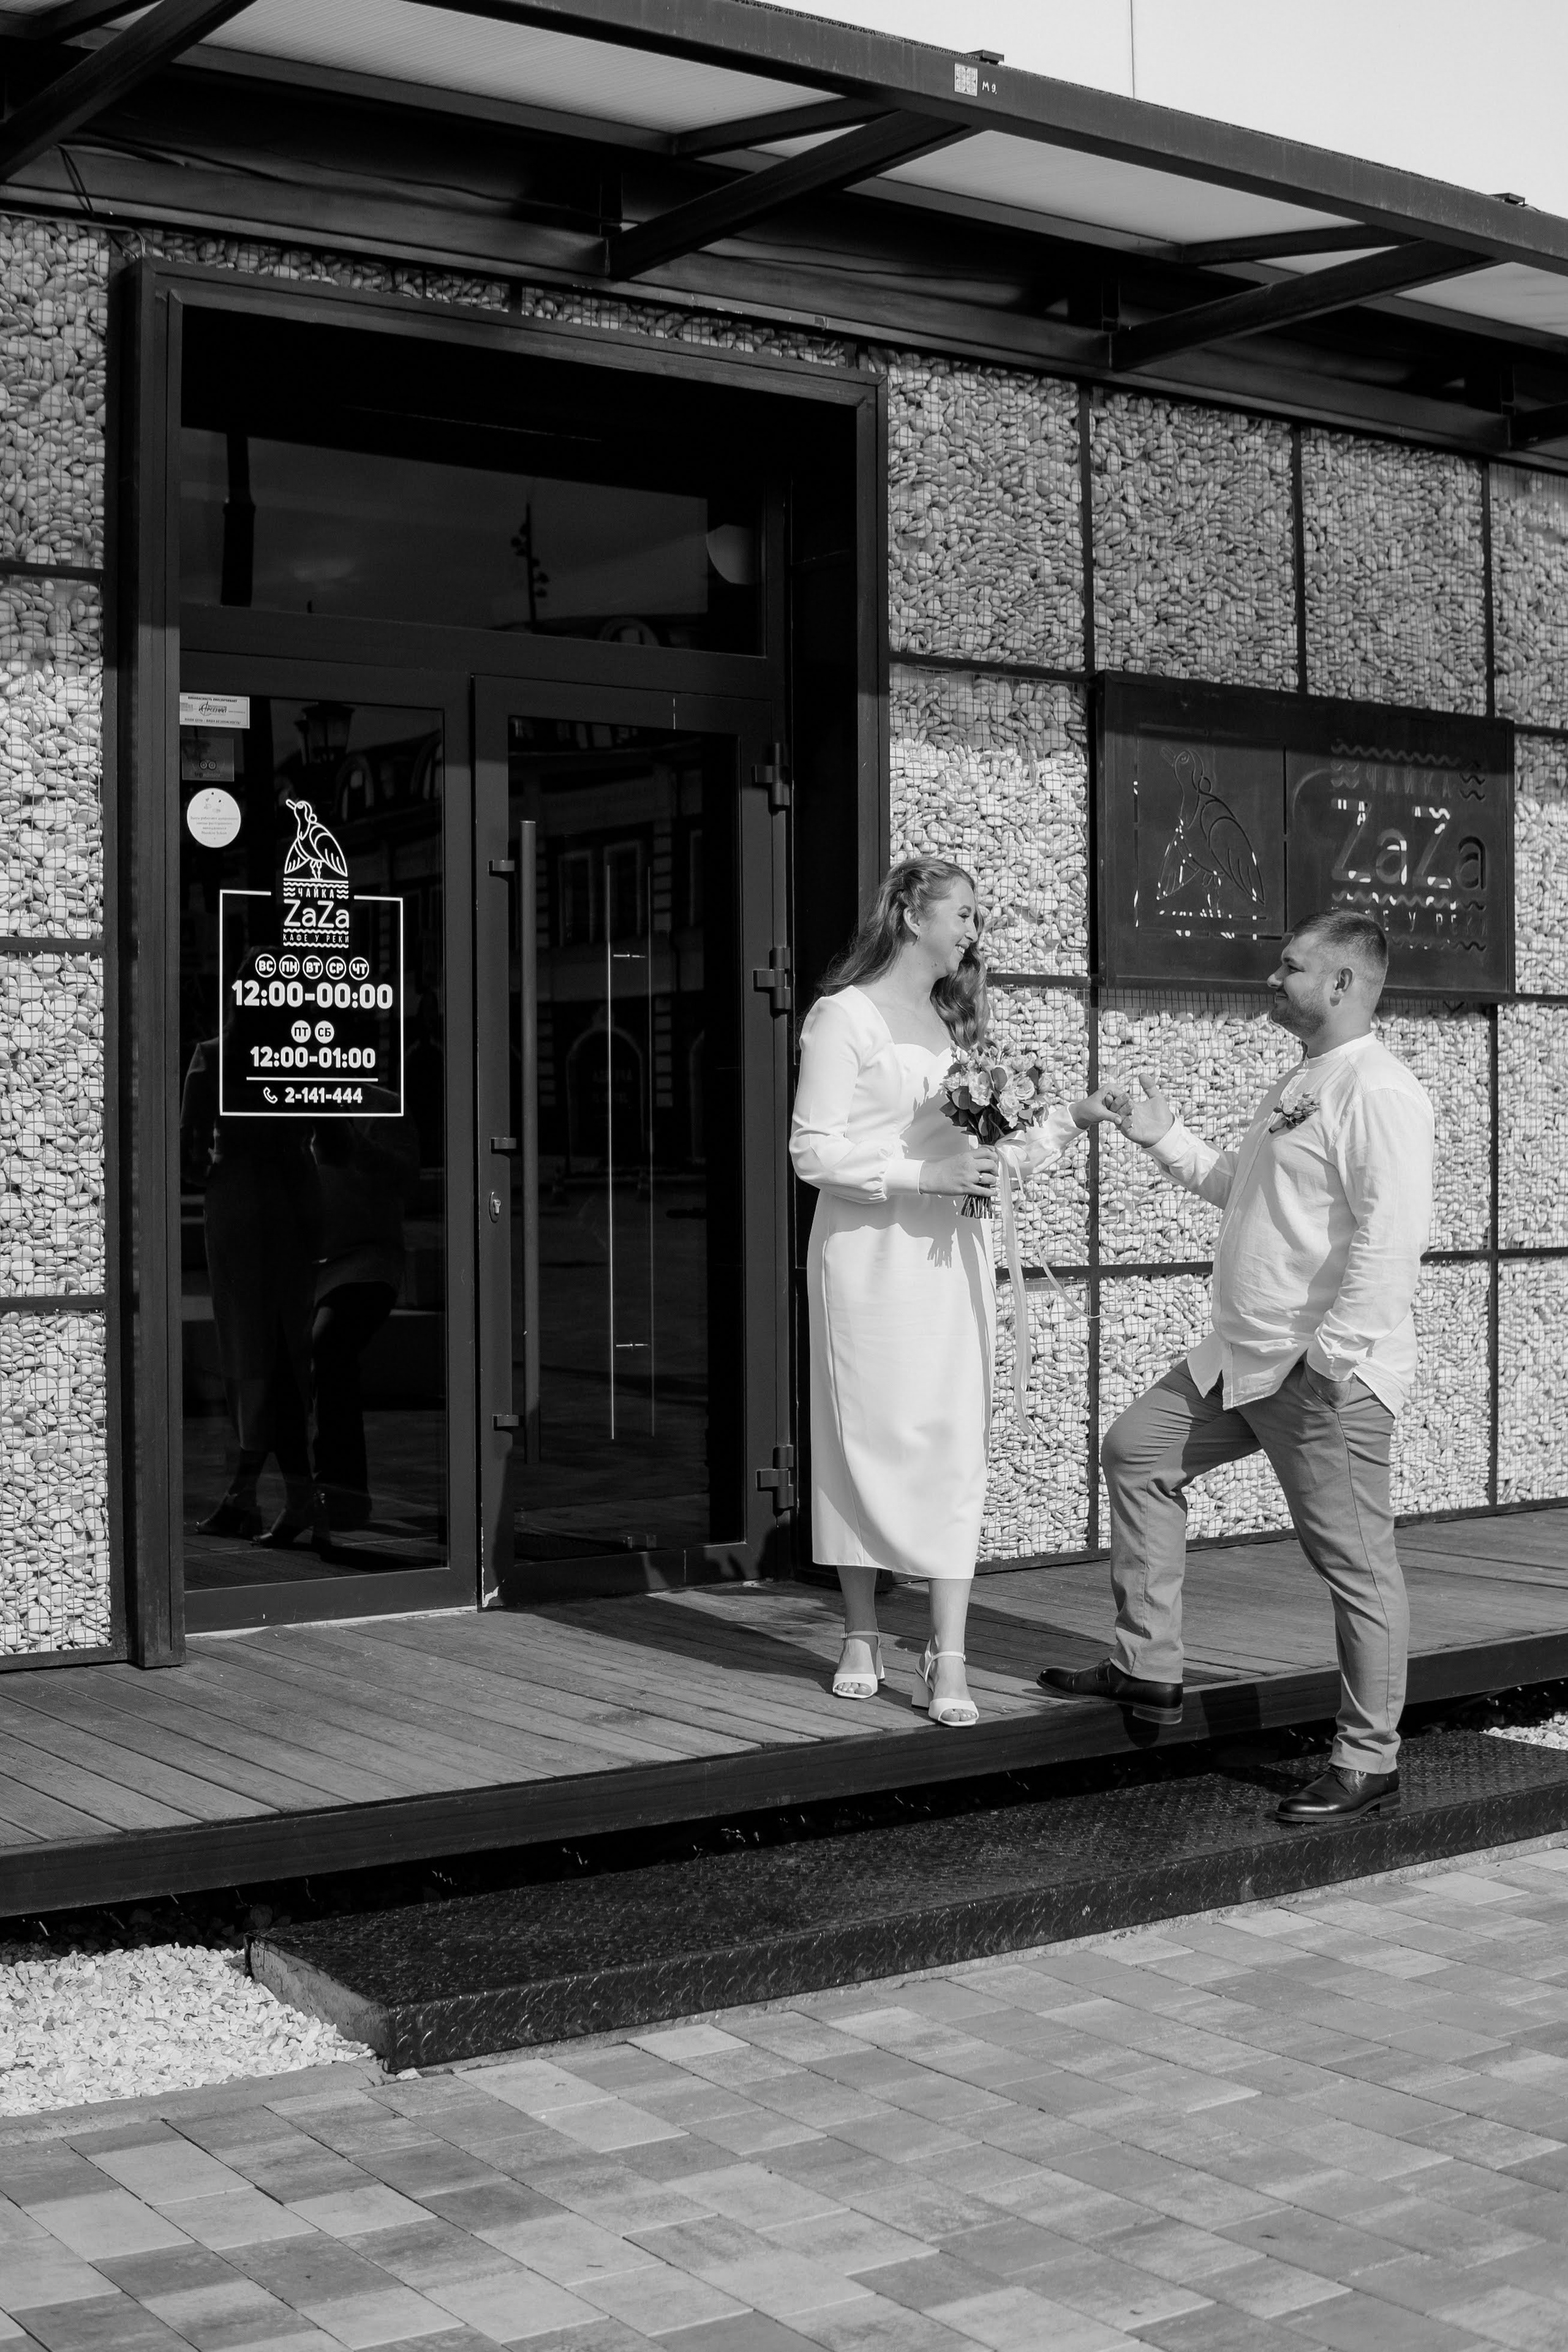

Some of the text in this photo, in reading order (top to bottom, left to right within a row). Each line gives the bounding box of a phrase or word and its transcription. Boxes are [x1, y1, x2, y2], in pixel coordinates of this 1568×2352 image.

[1330, 798, 1488, 891] ZaZa
[298, 887, 334, 899] ЧАЙКА
[284, 899, 350, 929] ZaZa
[283, 933, 307, 942] КАФЕ
[326, 935, 349, 943] РЕКИ
[258, 960, 367, 974] ВС ПН ВТ СР ЧТ
[232, 979, 393, 1009] 12:00-00:00
[294, 1027, 331, 1037] ПТ СБ
[250, 1046, 375, 1068] 12:00-01:00
[285, 1087, 363, 1104] 2-141-444
